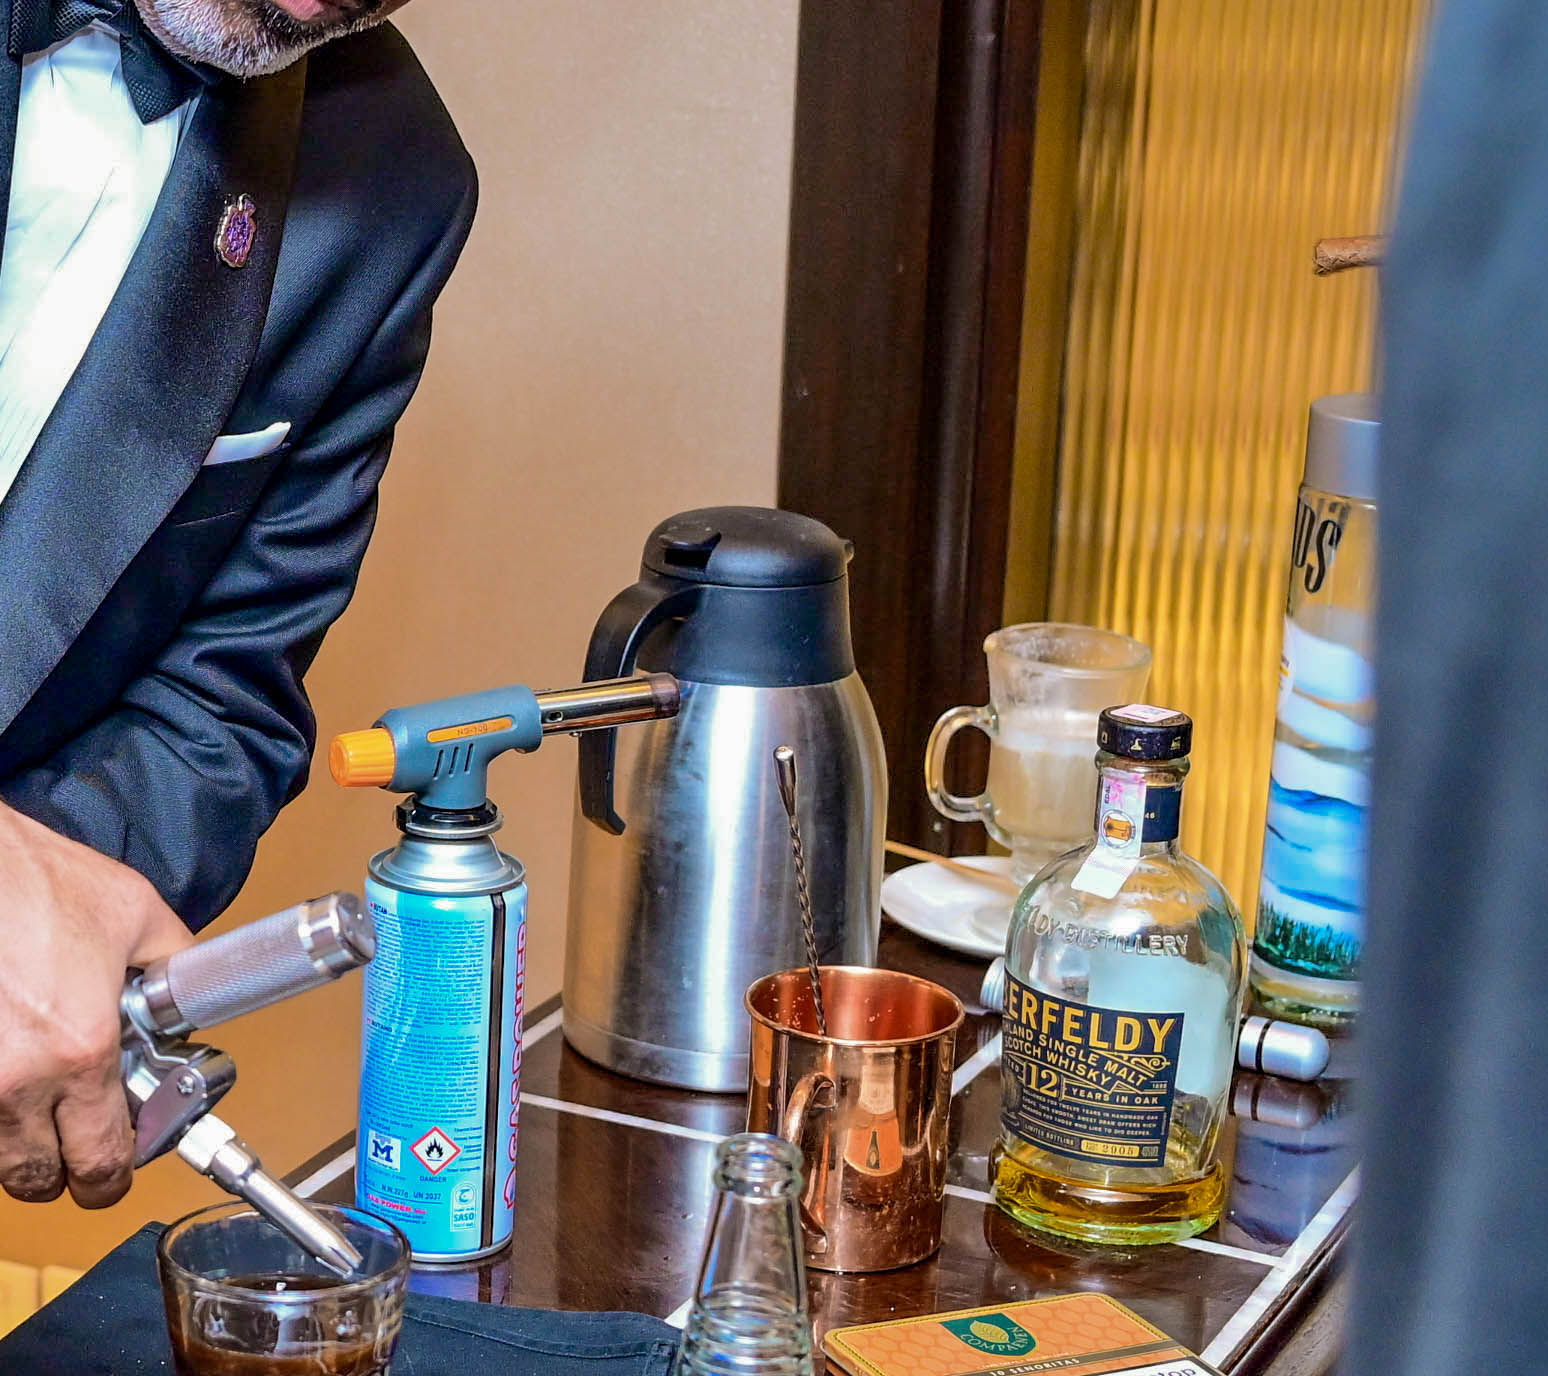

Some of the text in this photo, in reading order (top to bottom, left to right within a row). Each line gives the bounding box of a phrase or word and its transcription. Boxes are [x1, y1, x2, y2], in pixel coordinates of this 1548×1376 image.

[1005, 1035, 1042, 1059] SCOTCH
[1047, 1050, 1112, 1086] WHISKY
[1038, 1035, 1099, 1067] SINGLE
[1104, 1061, 1148, 1087] MALT
[1026, 1062, 1058, 1098] 12
[1072, 1088, 1159, 1105] YEARS IN OAK
[419, 1175, 447, 1183] DANGER
[453, 1213, 475, 1222] SASO
